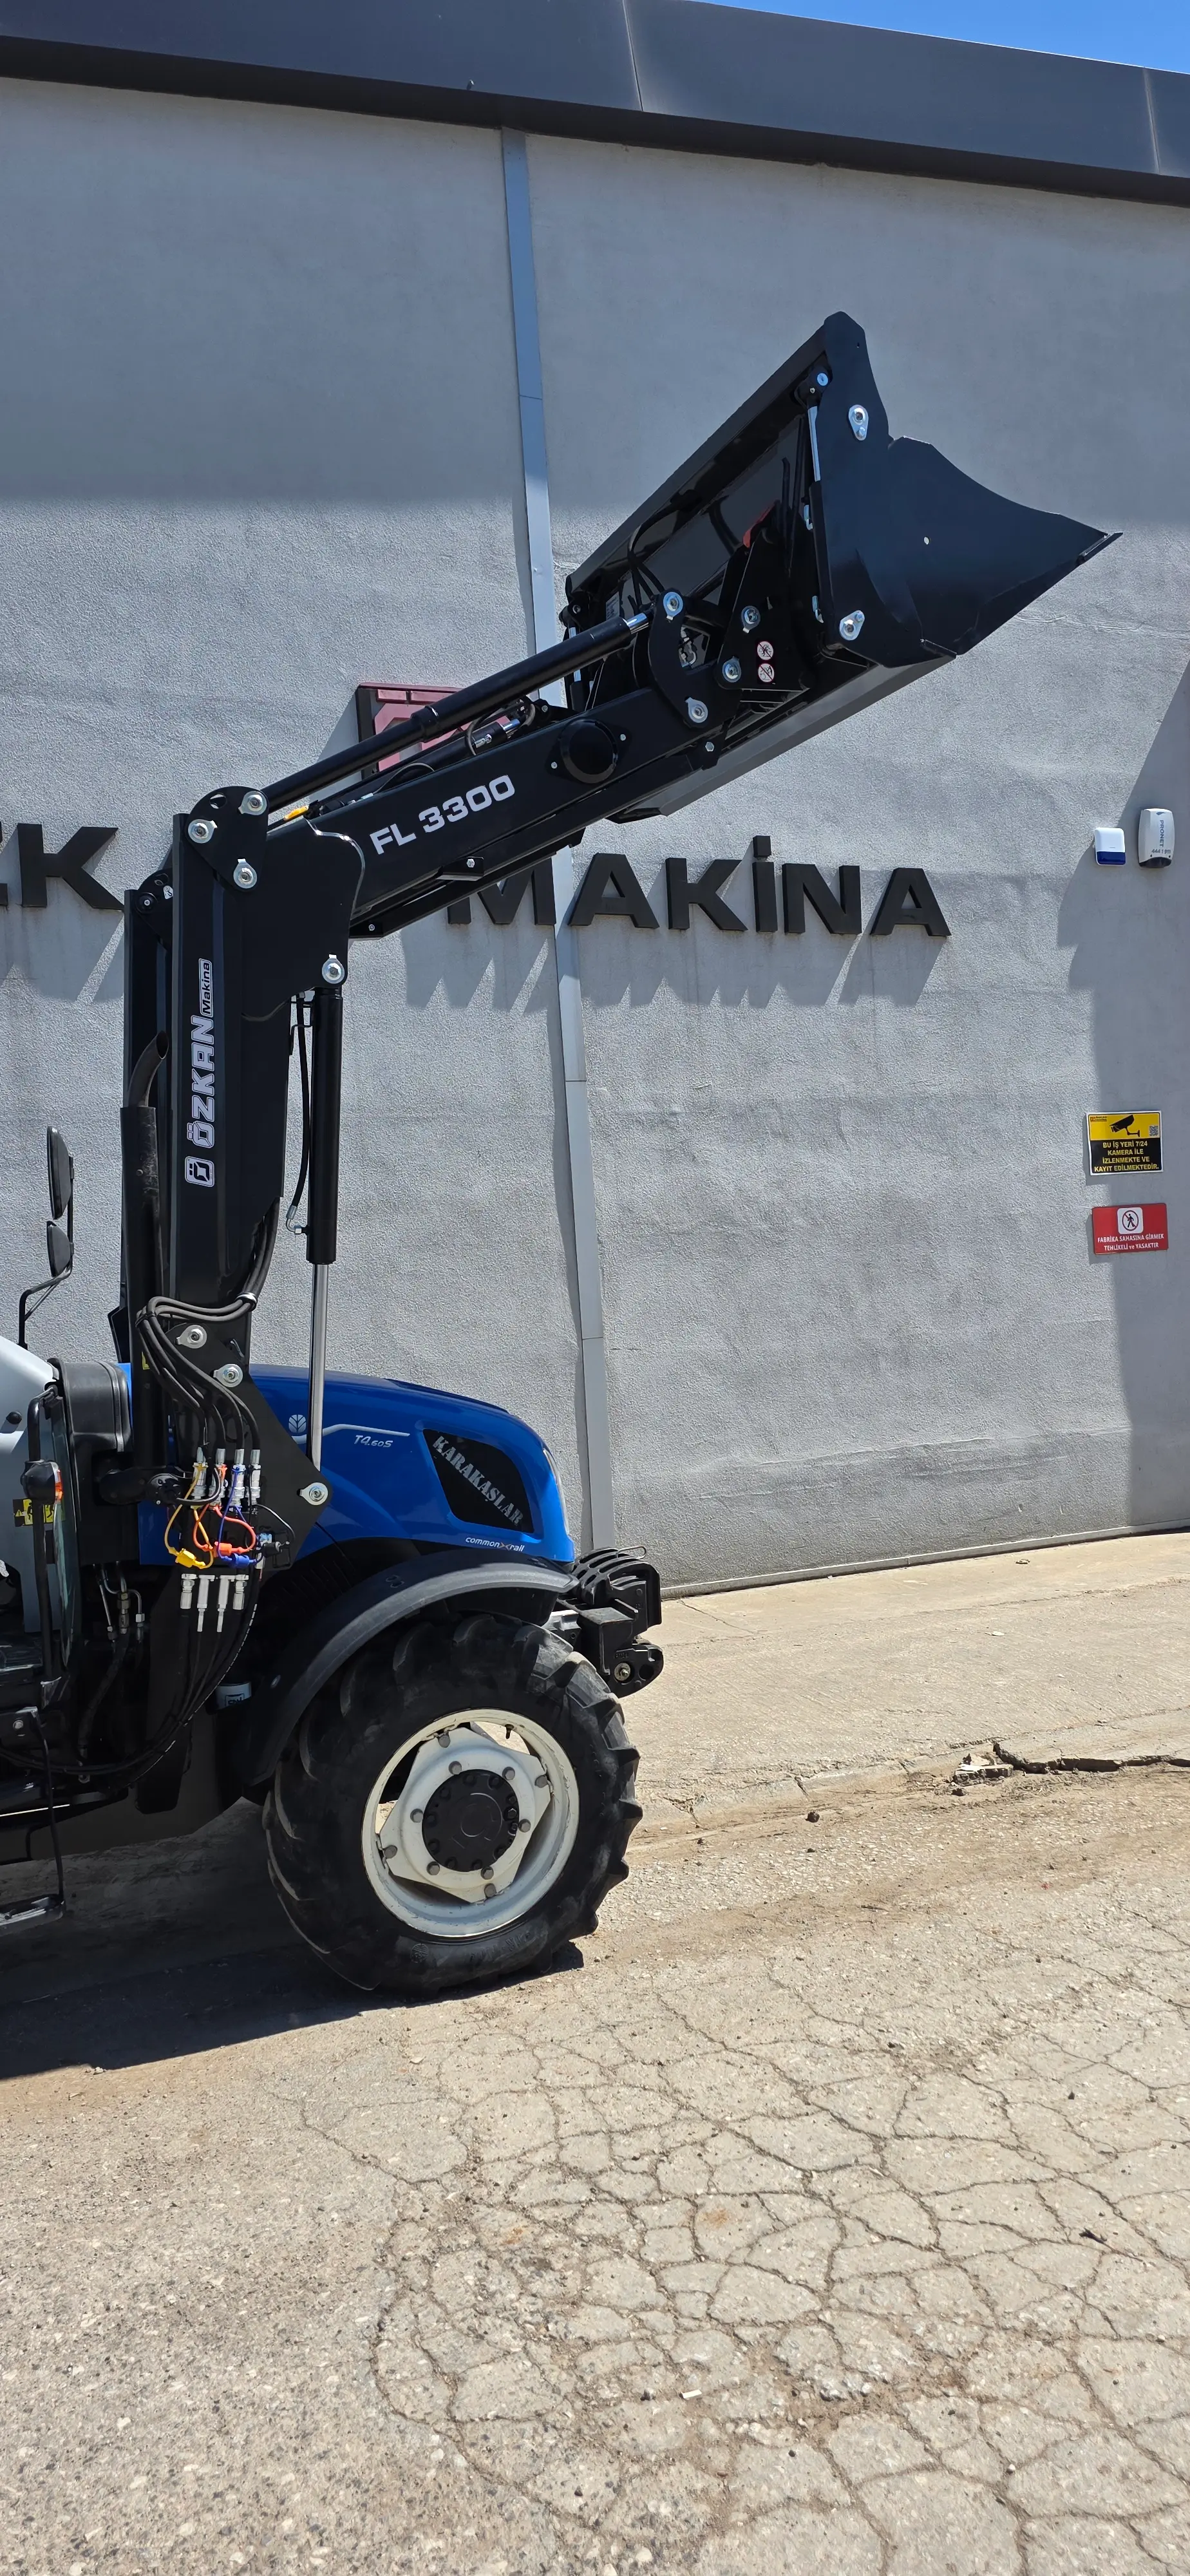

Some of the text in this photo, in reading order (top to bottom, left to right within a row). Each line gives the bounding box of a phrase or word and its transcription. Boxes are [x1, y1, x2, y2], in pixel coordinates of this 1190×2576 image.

[370, 775, 515, 855] FL 3300
[187, 1015, 214, 1148] ÖZKAN
[202, 961, 211, 1015] Makina
[354, 1435, 393, 1448] T4.60S
[433, 1435, 524, 1526] KARAKAŞLAR
